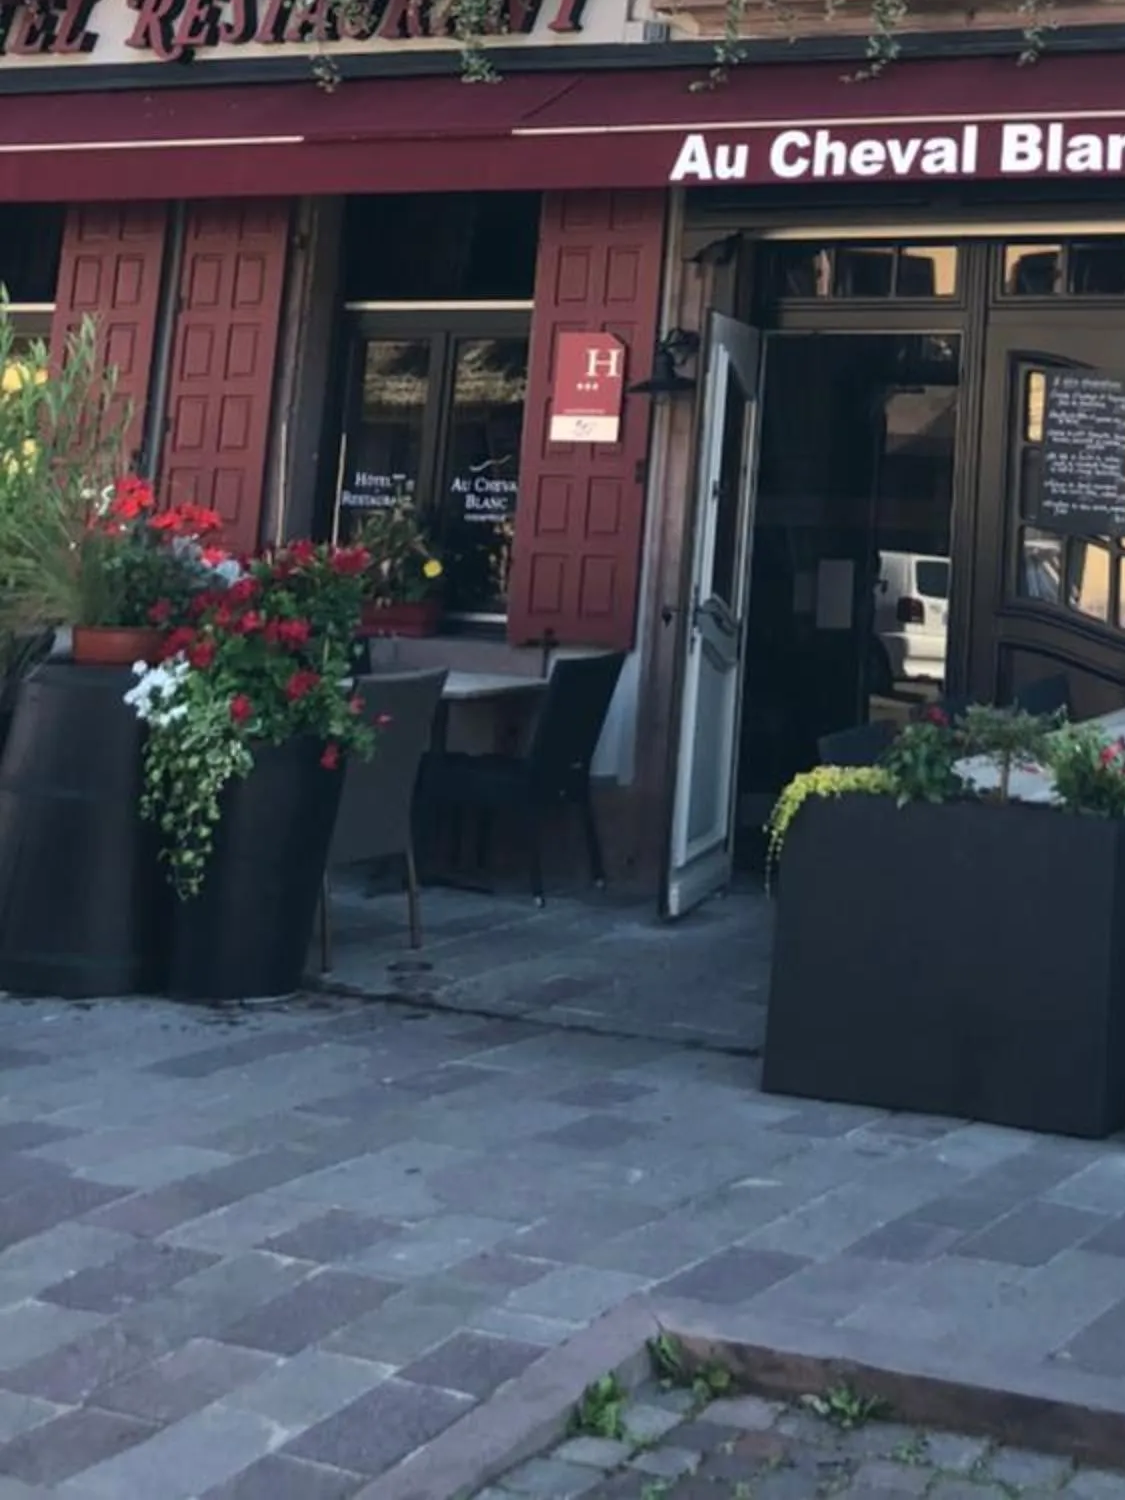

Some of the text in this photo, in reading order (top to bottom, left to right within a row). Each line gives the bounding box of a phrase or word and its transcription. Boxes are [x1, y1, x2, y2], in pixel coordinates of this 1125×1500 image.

[669, 134, 749, 181] Au
[769, 124, 979, 178] Cheval
[585, 348, 621, 377] H
[475, 476, 518, 492] CHEVA
[465, 494, 508, 510] BLANC
